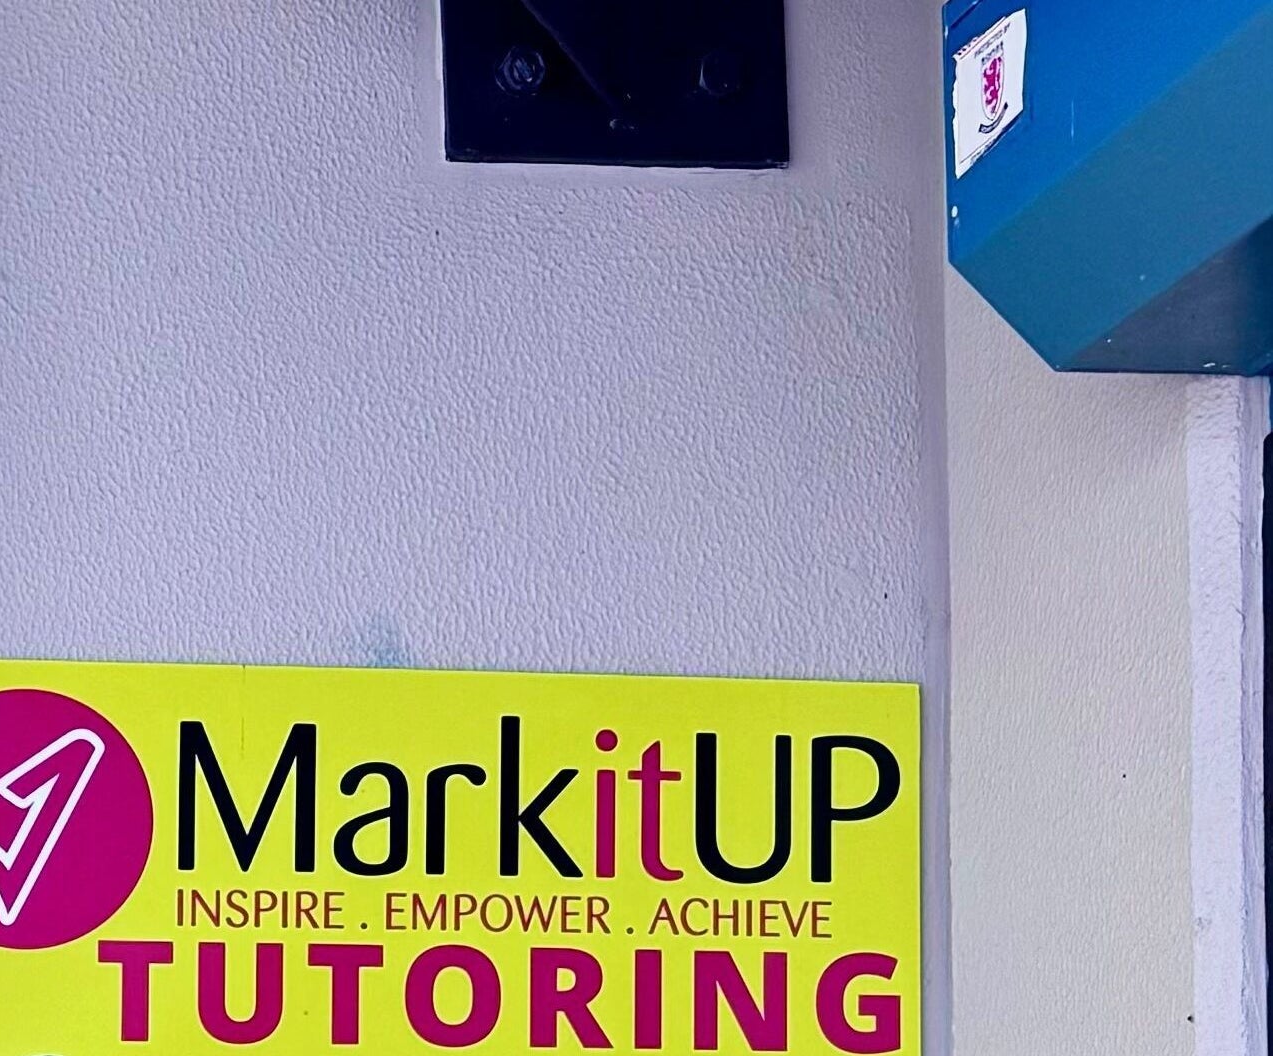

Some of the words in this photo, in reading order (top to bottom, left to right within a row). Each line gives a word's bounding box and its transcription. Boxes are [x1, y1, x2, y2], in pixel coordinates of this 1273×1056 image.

[177, 715, 901, 885] MarkitUP
[177, 888, 345, 930] INSPIRE
[385, 892, 611, 934] EMPOWER
[648, 897, 833, 939] ACHIEVE
[97, 939, 902, 1055] TUTORING
